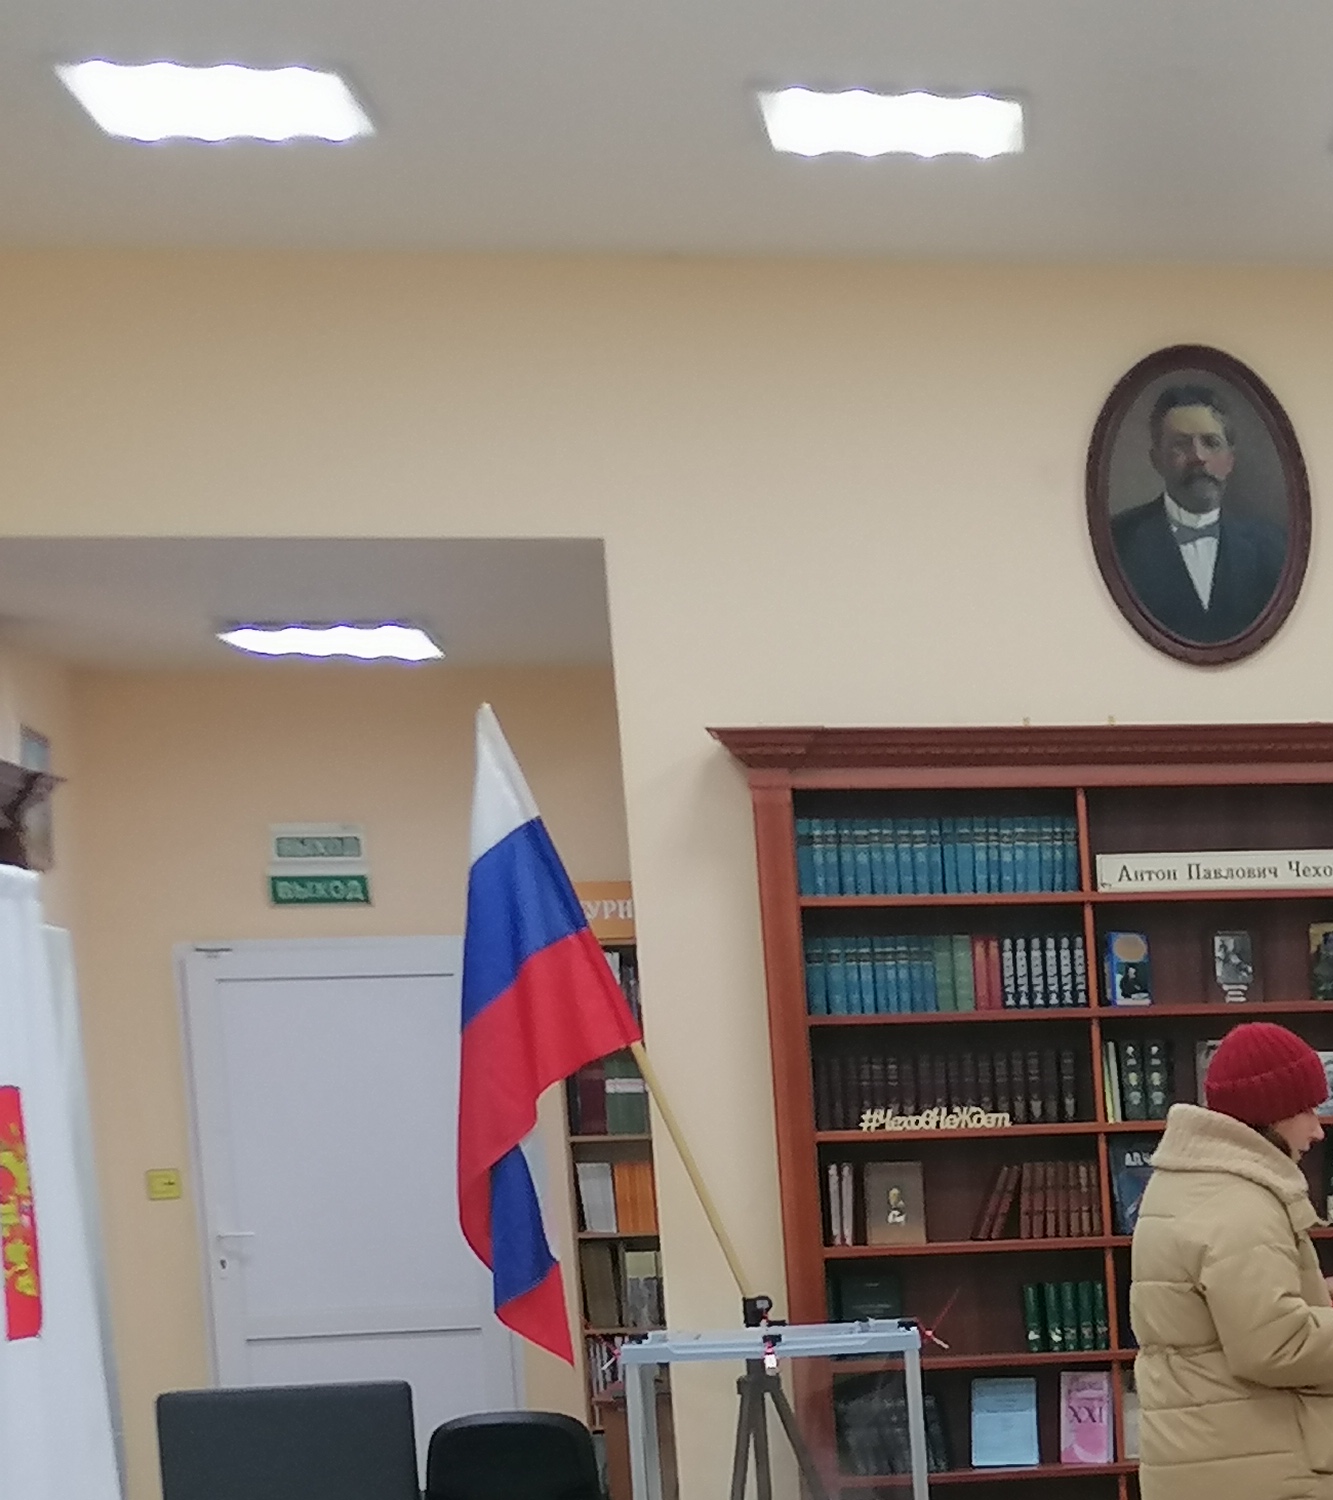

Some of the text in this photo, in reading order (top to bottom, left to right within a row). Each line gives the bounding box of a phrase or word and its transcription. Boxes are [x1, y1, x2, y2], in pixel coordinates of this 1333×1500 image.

[1117, 865, 1178, 883] Антон
[1187, 862, 1279, 880] Павлович
[276, 880, 364, 900] ВЫХОД
